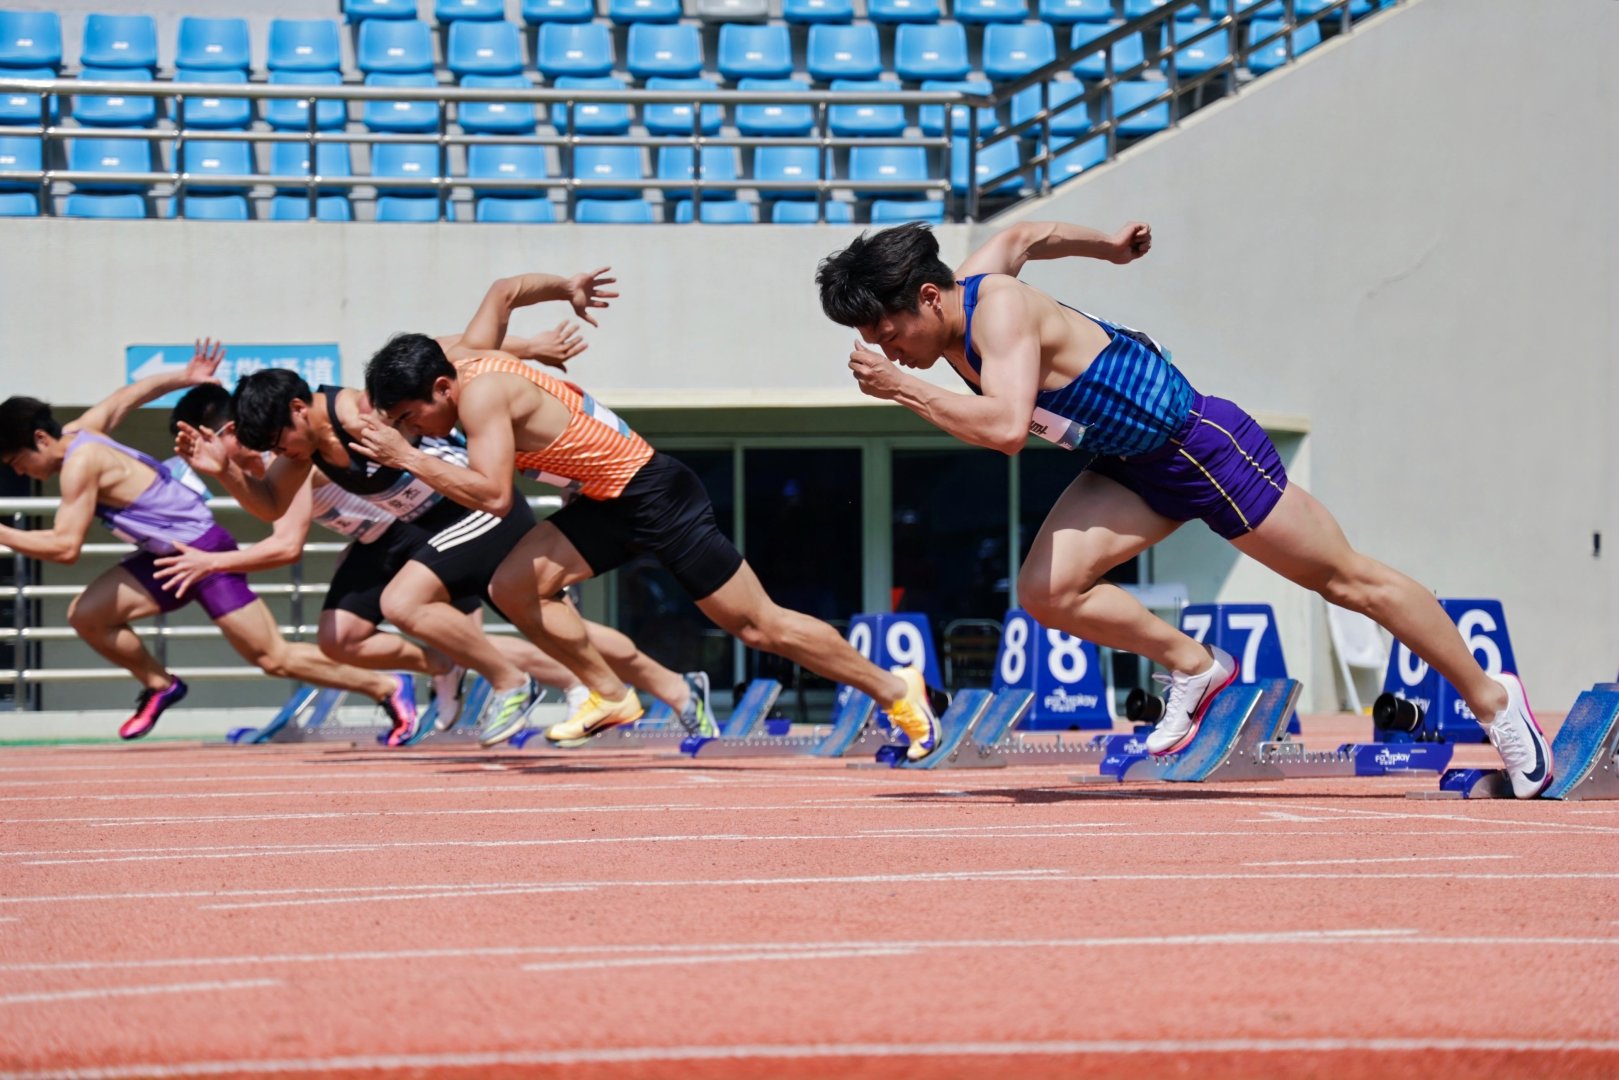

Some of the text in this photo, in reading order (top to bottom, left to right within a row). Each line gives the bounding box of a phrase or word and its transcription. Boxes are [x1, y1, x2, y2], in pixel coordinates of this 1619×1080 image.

[885, 620, 926, 674] 9
[1001, 616, 1028, 684] 8
[1046, 628, 1088, 684] 8
[1227, 613, 1269, 684] 7
[1457, 608, 1502, 676] 6
